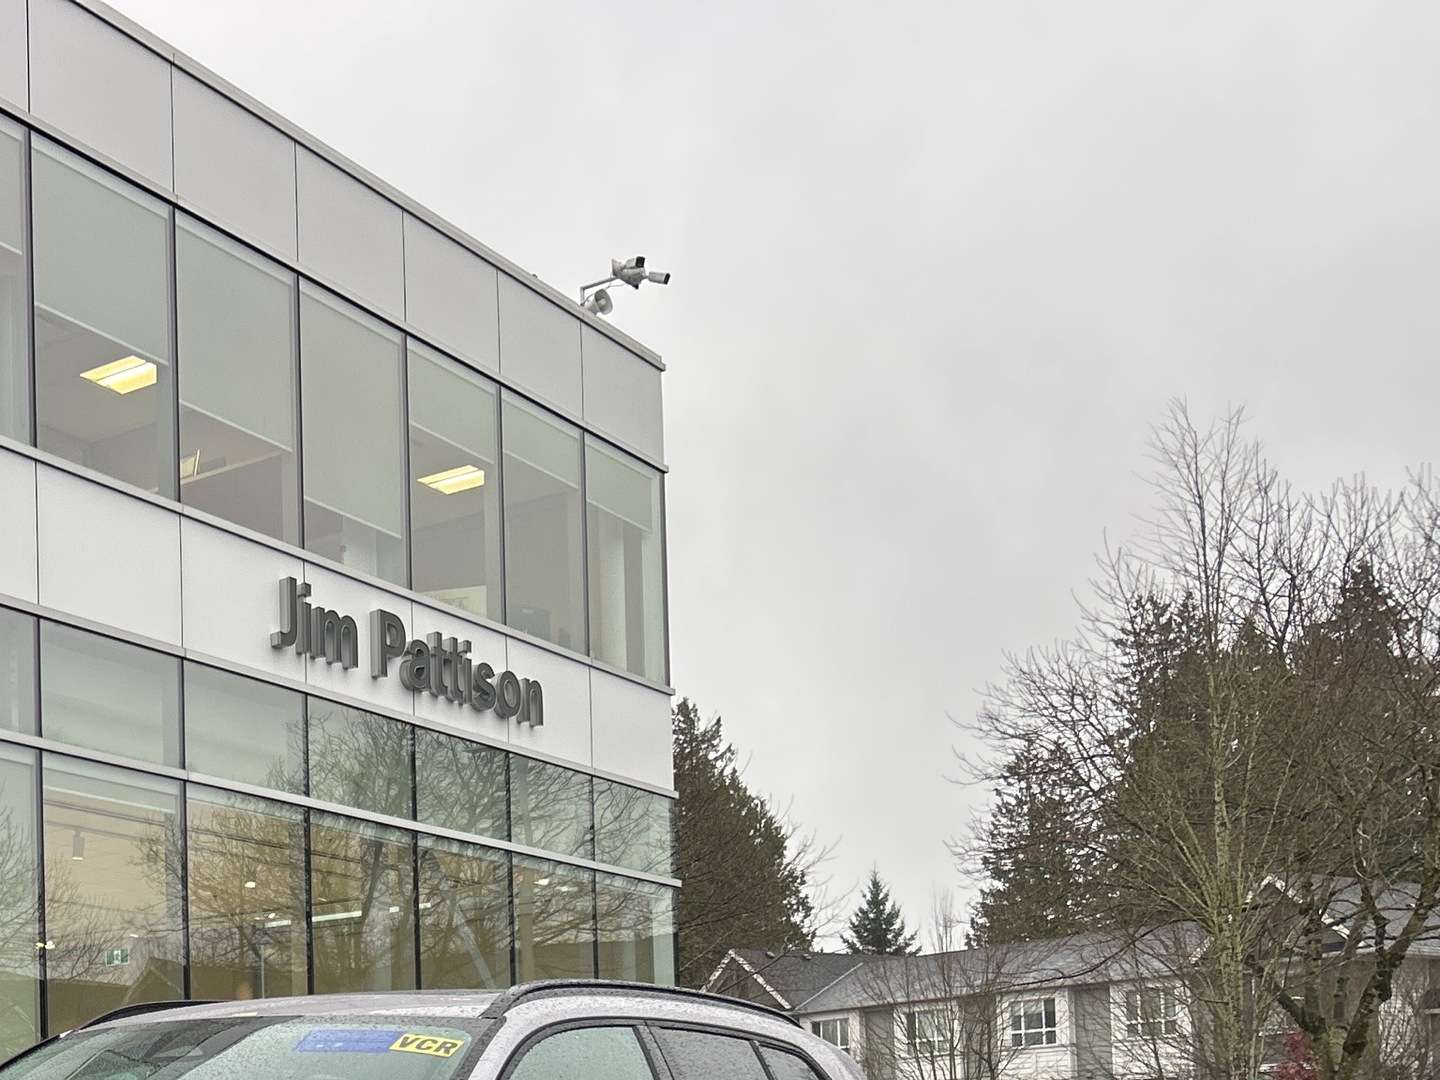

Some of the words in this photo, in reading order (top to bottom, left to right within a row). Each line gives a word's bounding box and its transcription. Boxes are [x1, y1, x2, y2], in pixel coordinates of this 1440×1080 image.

[270, 576, 358, 670] Jim
[369, 608, 544, 727] Pattison
[398, 1035, 458, 1055] VCR
